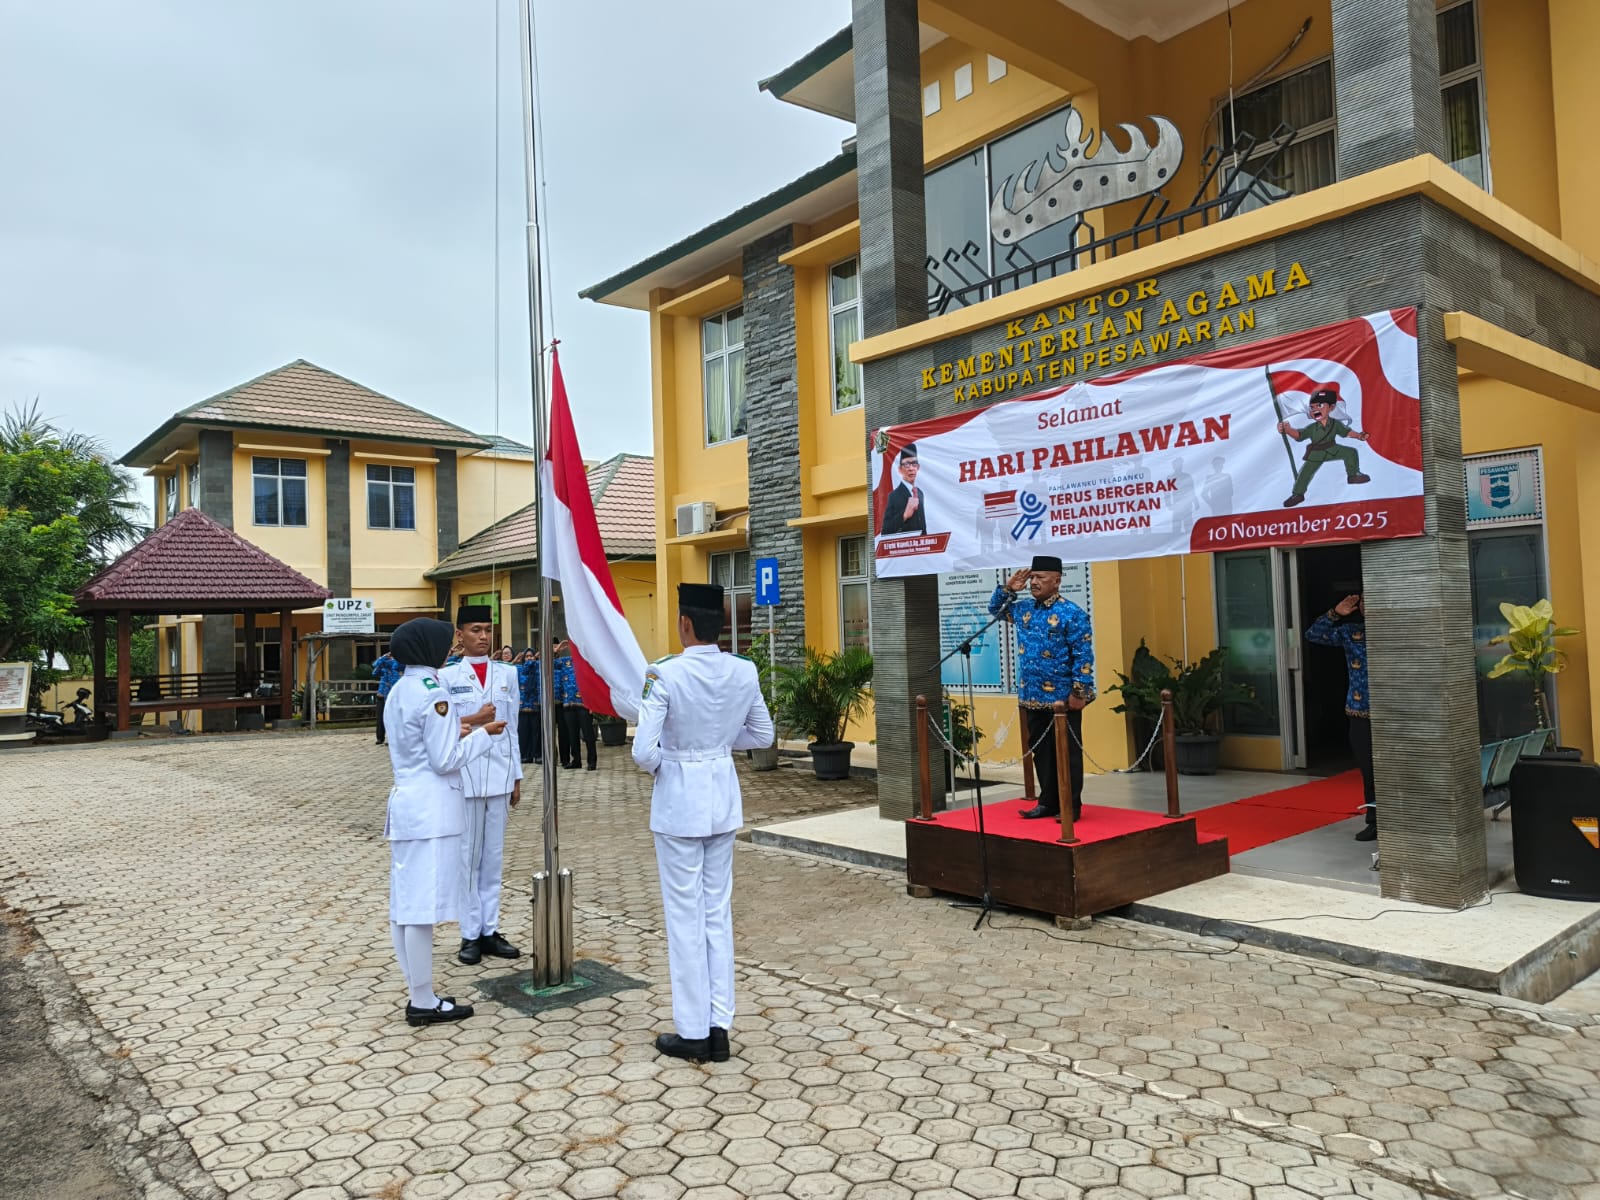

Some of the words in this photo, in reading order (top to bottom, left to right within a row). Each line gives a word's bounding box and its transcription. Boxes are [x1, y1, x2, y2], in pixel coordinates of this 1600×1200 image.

[1005, 278, 1160, 340] KANTOR
[921, 307, 1143, 390] KEMENTERIAN
[1158, 262, 1311, 326] AGAMA
[954, 357, 1075, 404] KABUPATEN
[1083, 308, 1256, 370] PESAWARAN
[1037, 398, 1122, 430] Selamat
[959, 451, 1025, 483] HARI
[1032, 413, 1231, 471] PAHLAWAN
[1048, 479, 1097, 492] PAHLAWANKU
[1099, 473, 1145, 485] TELADANKU
[1049, 490, 1092, 506] TERUS
[1097, 478, 1178, 501] BERGERAK
[1050, 497, 1161, 521] MELANJUTKAN
[1051, 515, 1151, 537] PERJUANGAN
[1207, 527, 1228, 541] 10
[1231, 515, 1331, 540] November
[1334, 511, 1388, 530] 2025
[762, 567, 773, 596] P
[337, 600, 362, 610] UPZ
